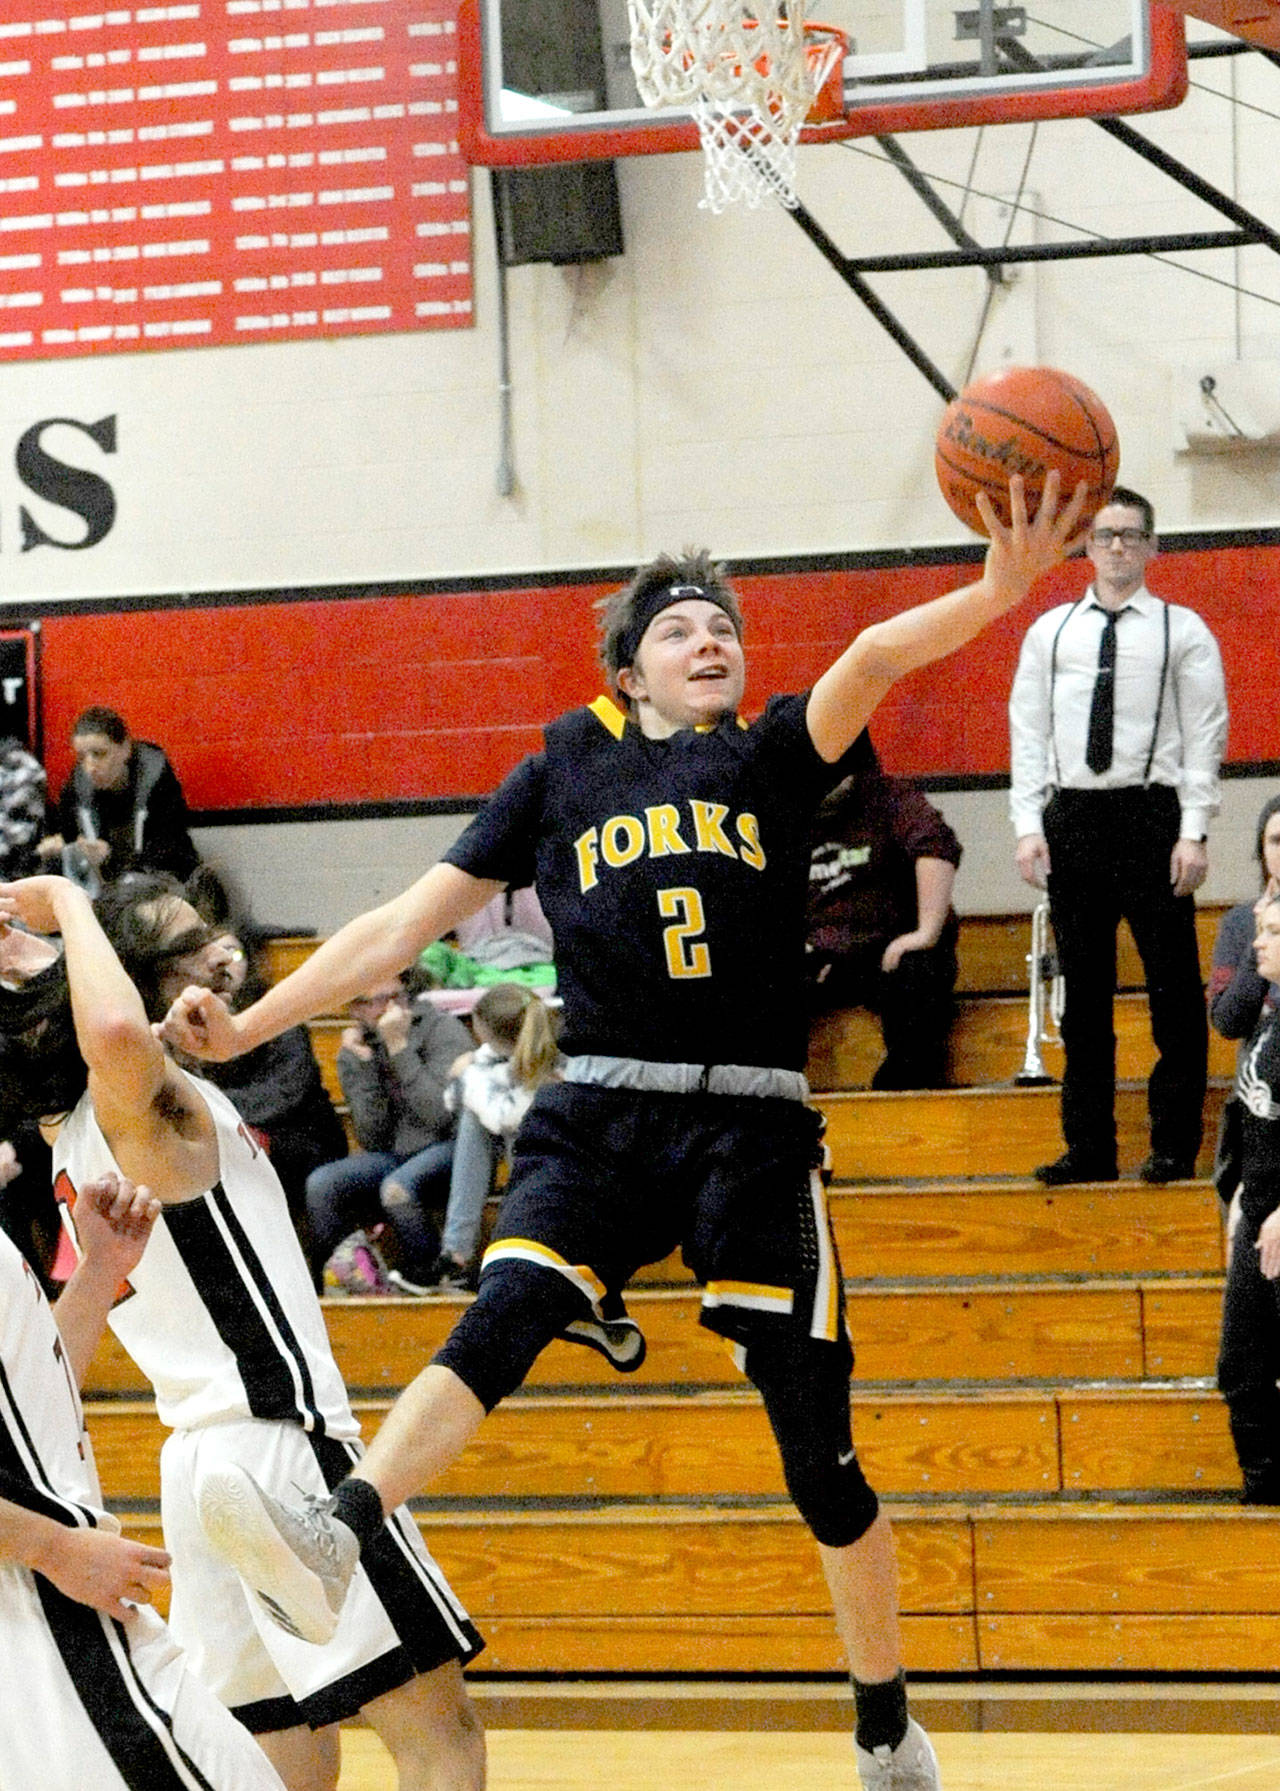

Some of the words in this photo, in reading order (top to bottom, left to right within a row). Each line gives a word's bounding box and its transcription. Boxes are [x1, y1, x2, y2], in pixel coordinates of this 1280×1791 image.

[16, 414, 117, 552] S
[574, 800, 767, 894] FORKS
[657, 887, 712, 979] 2
